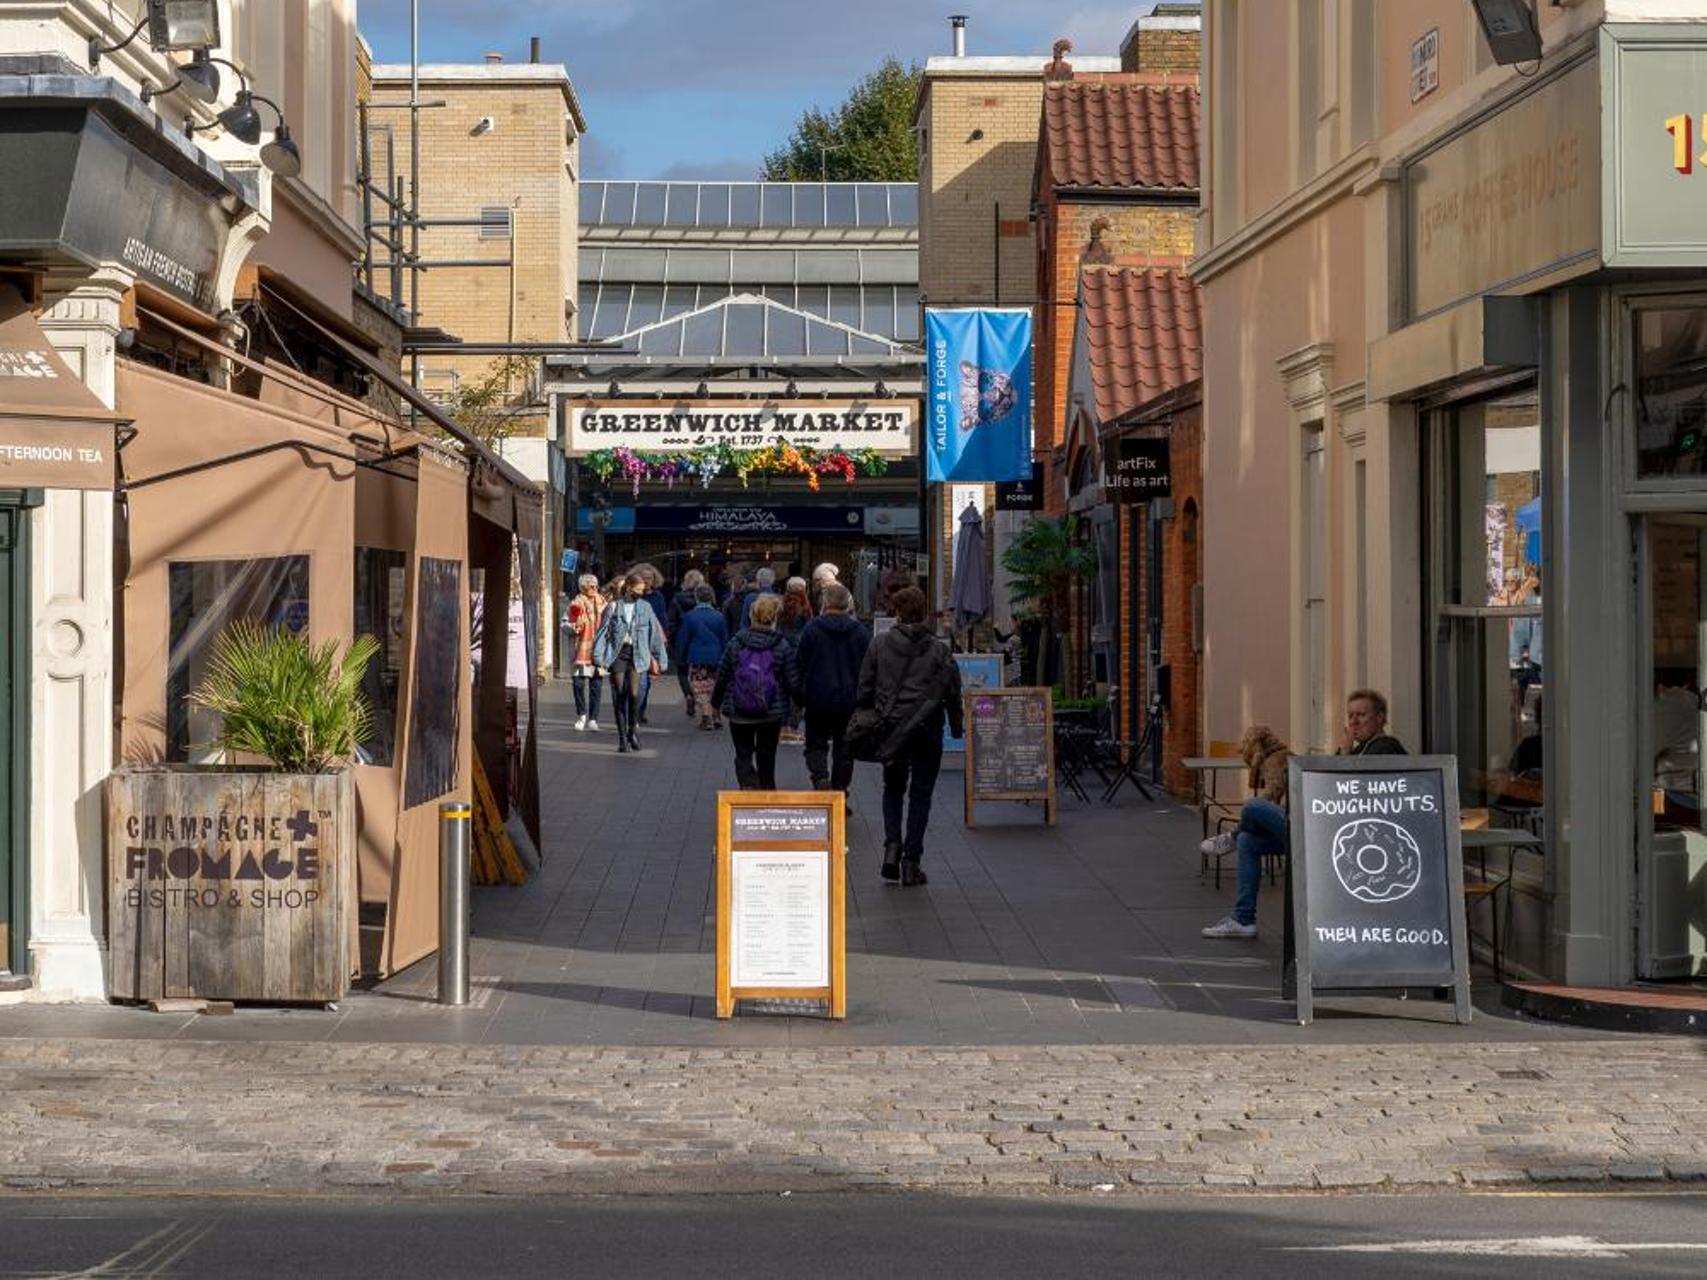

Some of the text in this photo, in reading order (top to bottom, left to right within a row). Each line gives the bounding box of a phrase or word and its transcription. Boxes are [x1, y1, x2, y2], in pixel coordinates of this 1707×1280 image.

[937, 340, 947, 387] FORGE
[581, 413, 903, 433] GREENWICH MARKET
[937, 404, 947, 451] TAILOR
[719, 435, 763, 447] Est. 1737
[77, 448, 103, 463] TEA
[1117, 457, 1156, 469] artFix
[1106, 475, 1168, 487] Life as art
[699, 512, 776, 521] HIMALAYA
[1336, 779, 1408, 795] WE HAVE
[1312, 795, 1439, 815] DOUGHNUTS.
[126, 847, 320, 880] FROMAGE
[127, 888, 319, 909] BISTRO & SHOP
[1315, 927, 1449, 945] THEY ARE GOOD.
